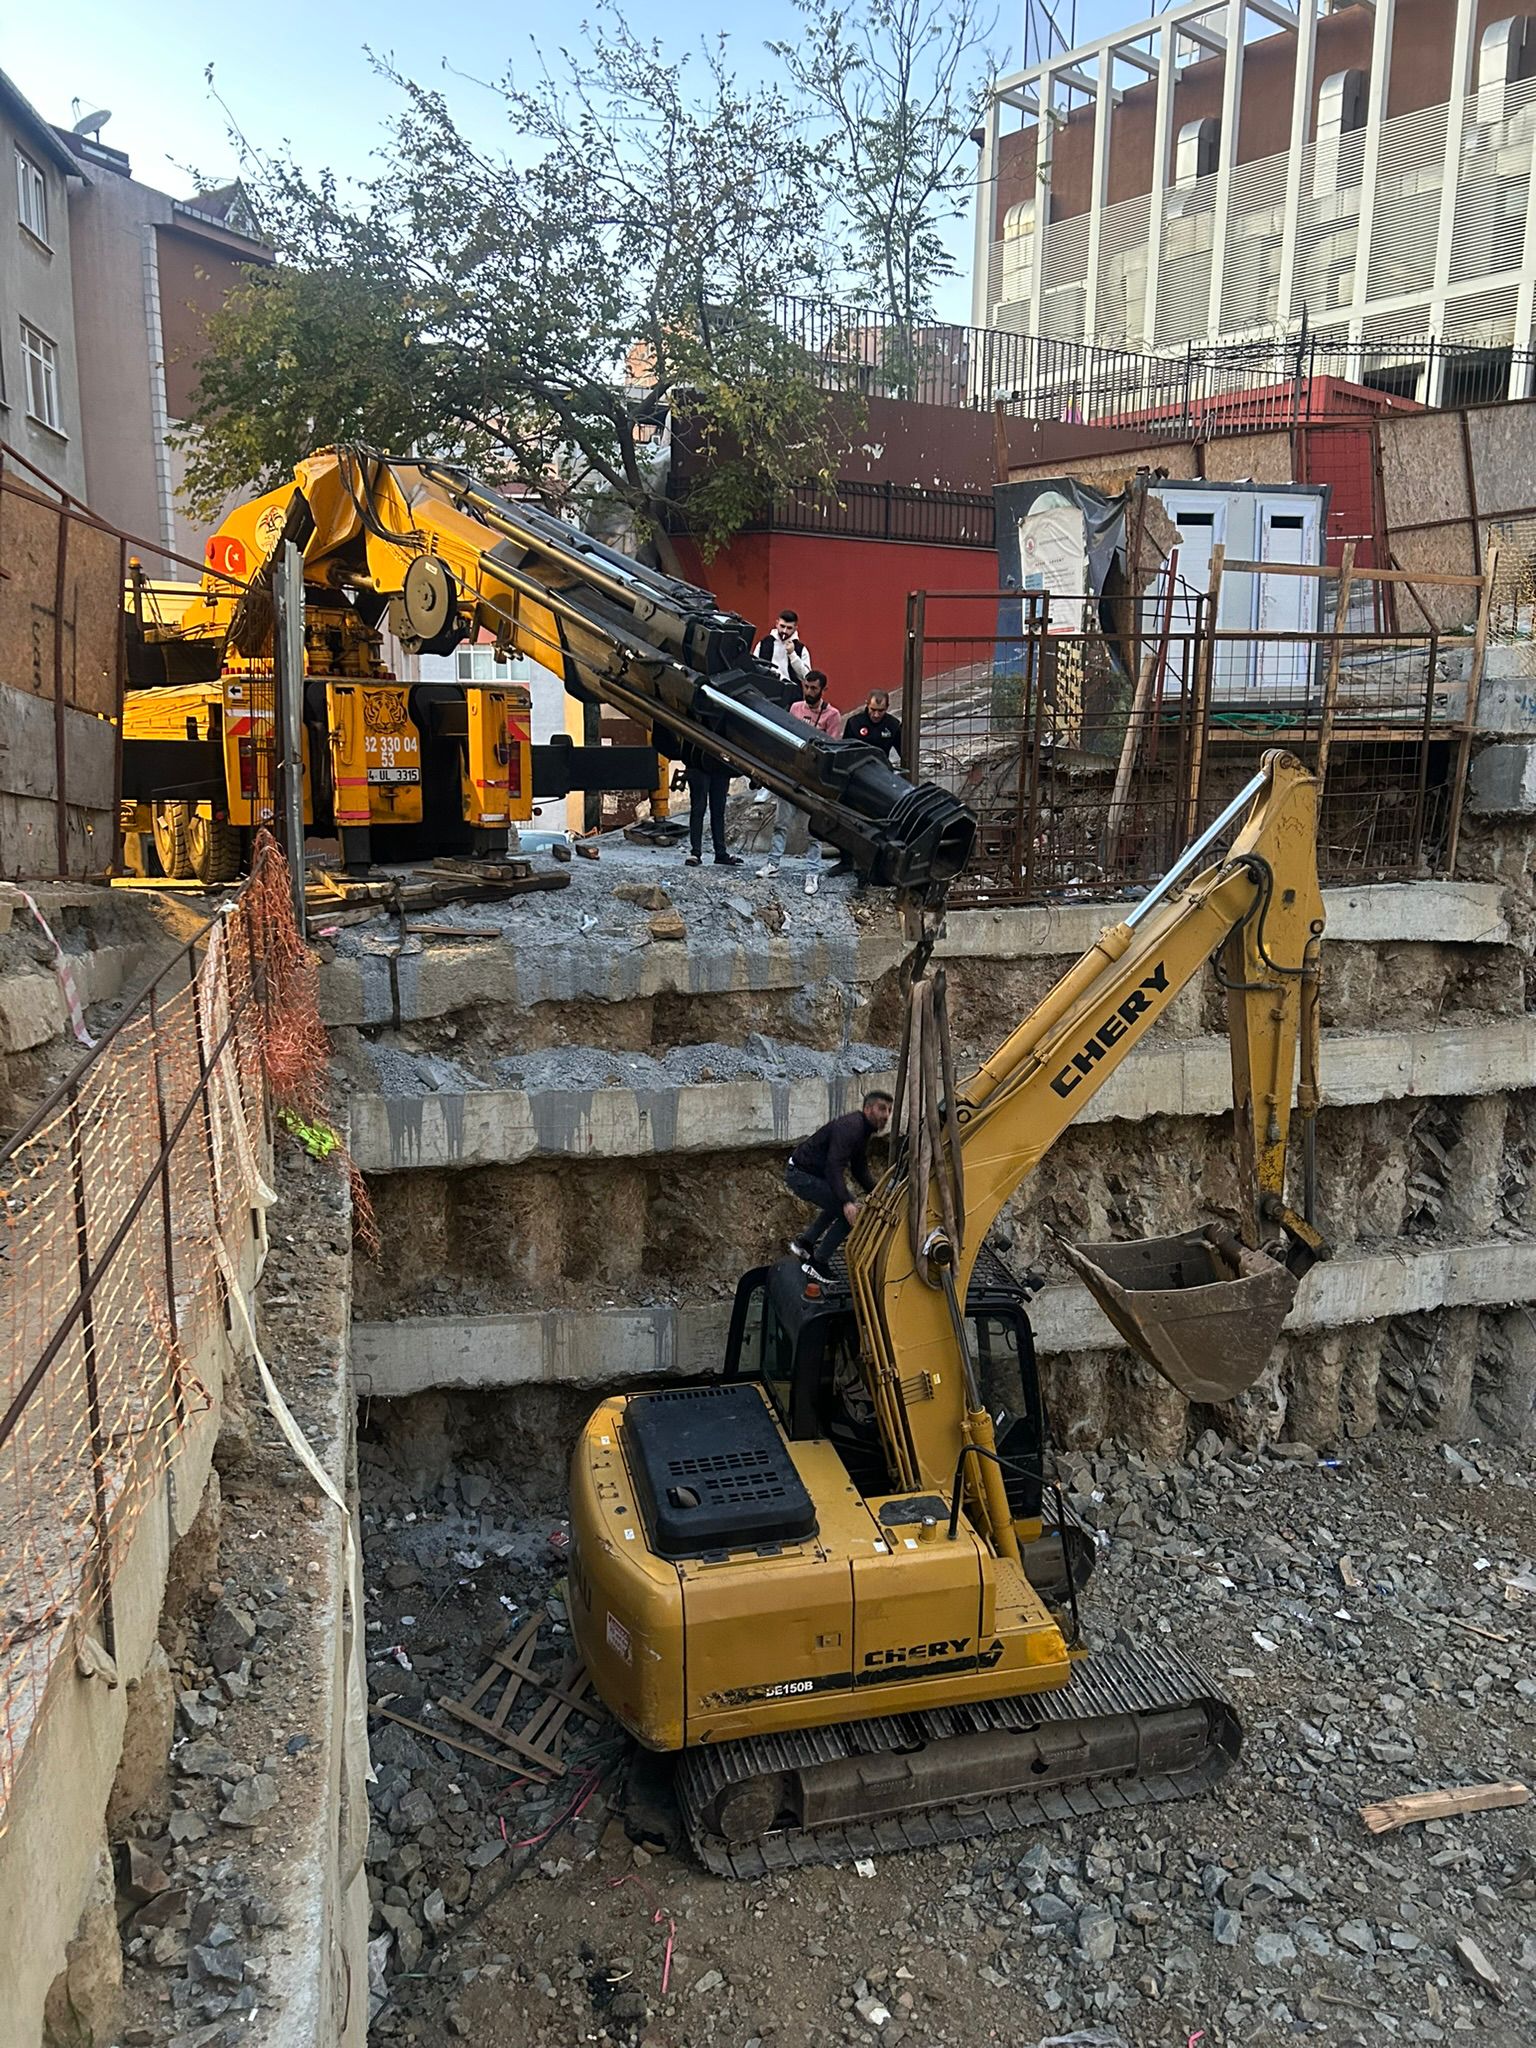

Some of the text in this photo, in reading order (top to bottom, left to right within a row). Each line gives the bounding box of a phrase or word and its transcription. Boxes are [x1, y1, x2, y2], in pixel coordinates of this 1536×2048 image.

[380, 736, 400, 752] 330
[404, 736, 417, 752] 04
[381, 751, 395, 767] 53
[379, 770, 390, 780] UL
[396, 770, 418, 780] 3315
[1050, 960, 1170, 1098] CHERY
[865, 1637, 971, 1666] CHERY
